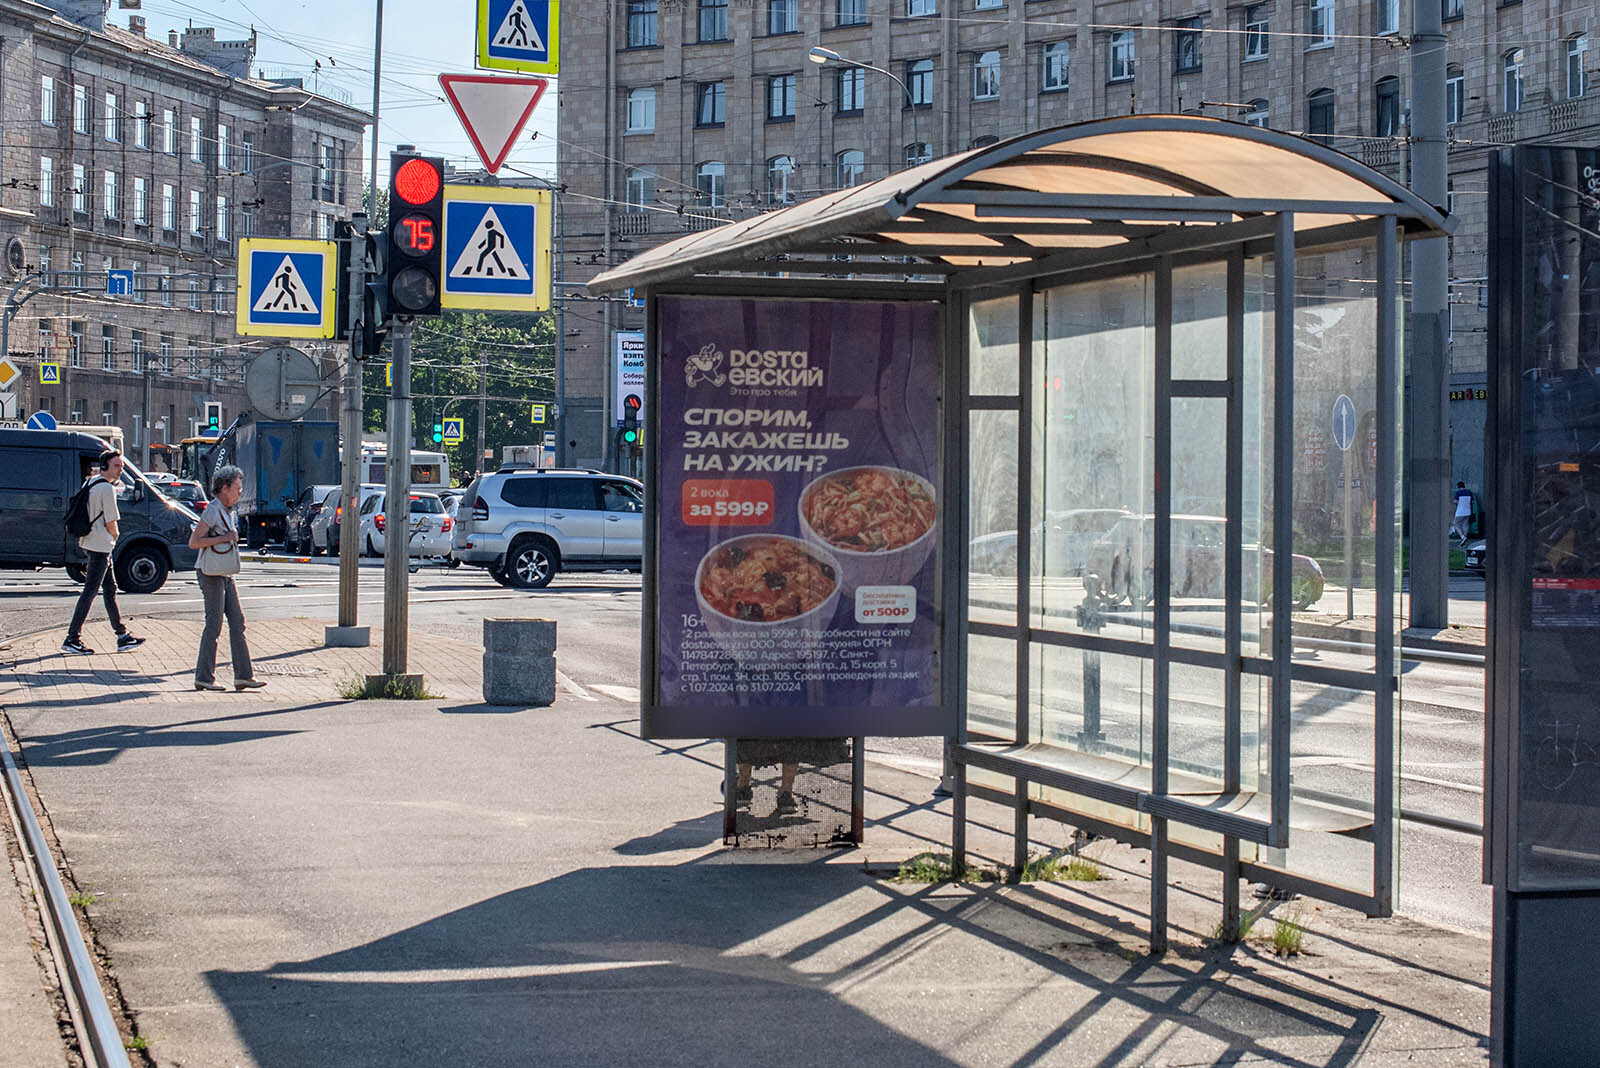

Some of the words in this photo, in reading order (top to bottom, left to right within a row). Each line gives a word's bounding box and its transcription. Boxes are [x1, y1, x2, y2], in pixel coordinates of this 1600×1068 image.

[402, 218, 432, 250] 75
[728, 386, 751, 396] Это
[751, 388, 772, 397] про
[683, 408, 812, 430] СПОРИМ,
[682, 430, 850, 450] ЗАКАЖЕШЬ
[214, 448, 226, 473] OLVO
[683, 454, 724, 472] НА
[727, 454, 828, 472] УЖИН?
[690, 486, 698, 498] 2
[700, 489, 729, 498] вока
[690, 504, 712, 516] за
[681, 614, 706, 628] 16+
[800, 628, 868, 640] Подробности
[882, 628, 911, 638] сайте
[862, 638, 892, 648] ОГРН
[840, 650, 874, 659] Санкт-
[850, 660, 862, 669] 15
[890, 659, 898, 668] 5
[794, 671, 826, 683] Сроки
[826, 672, 887, 682] проведения
